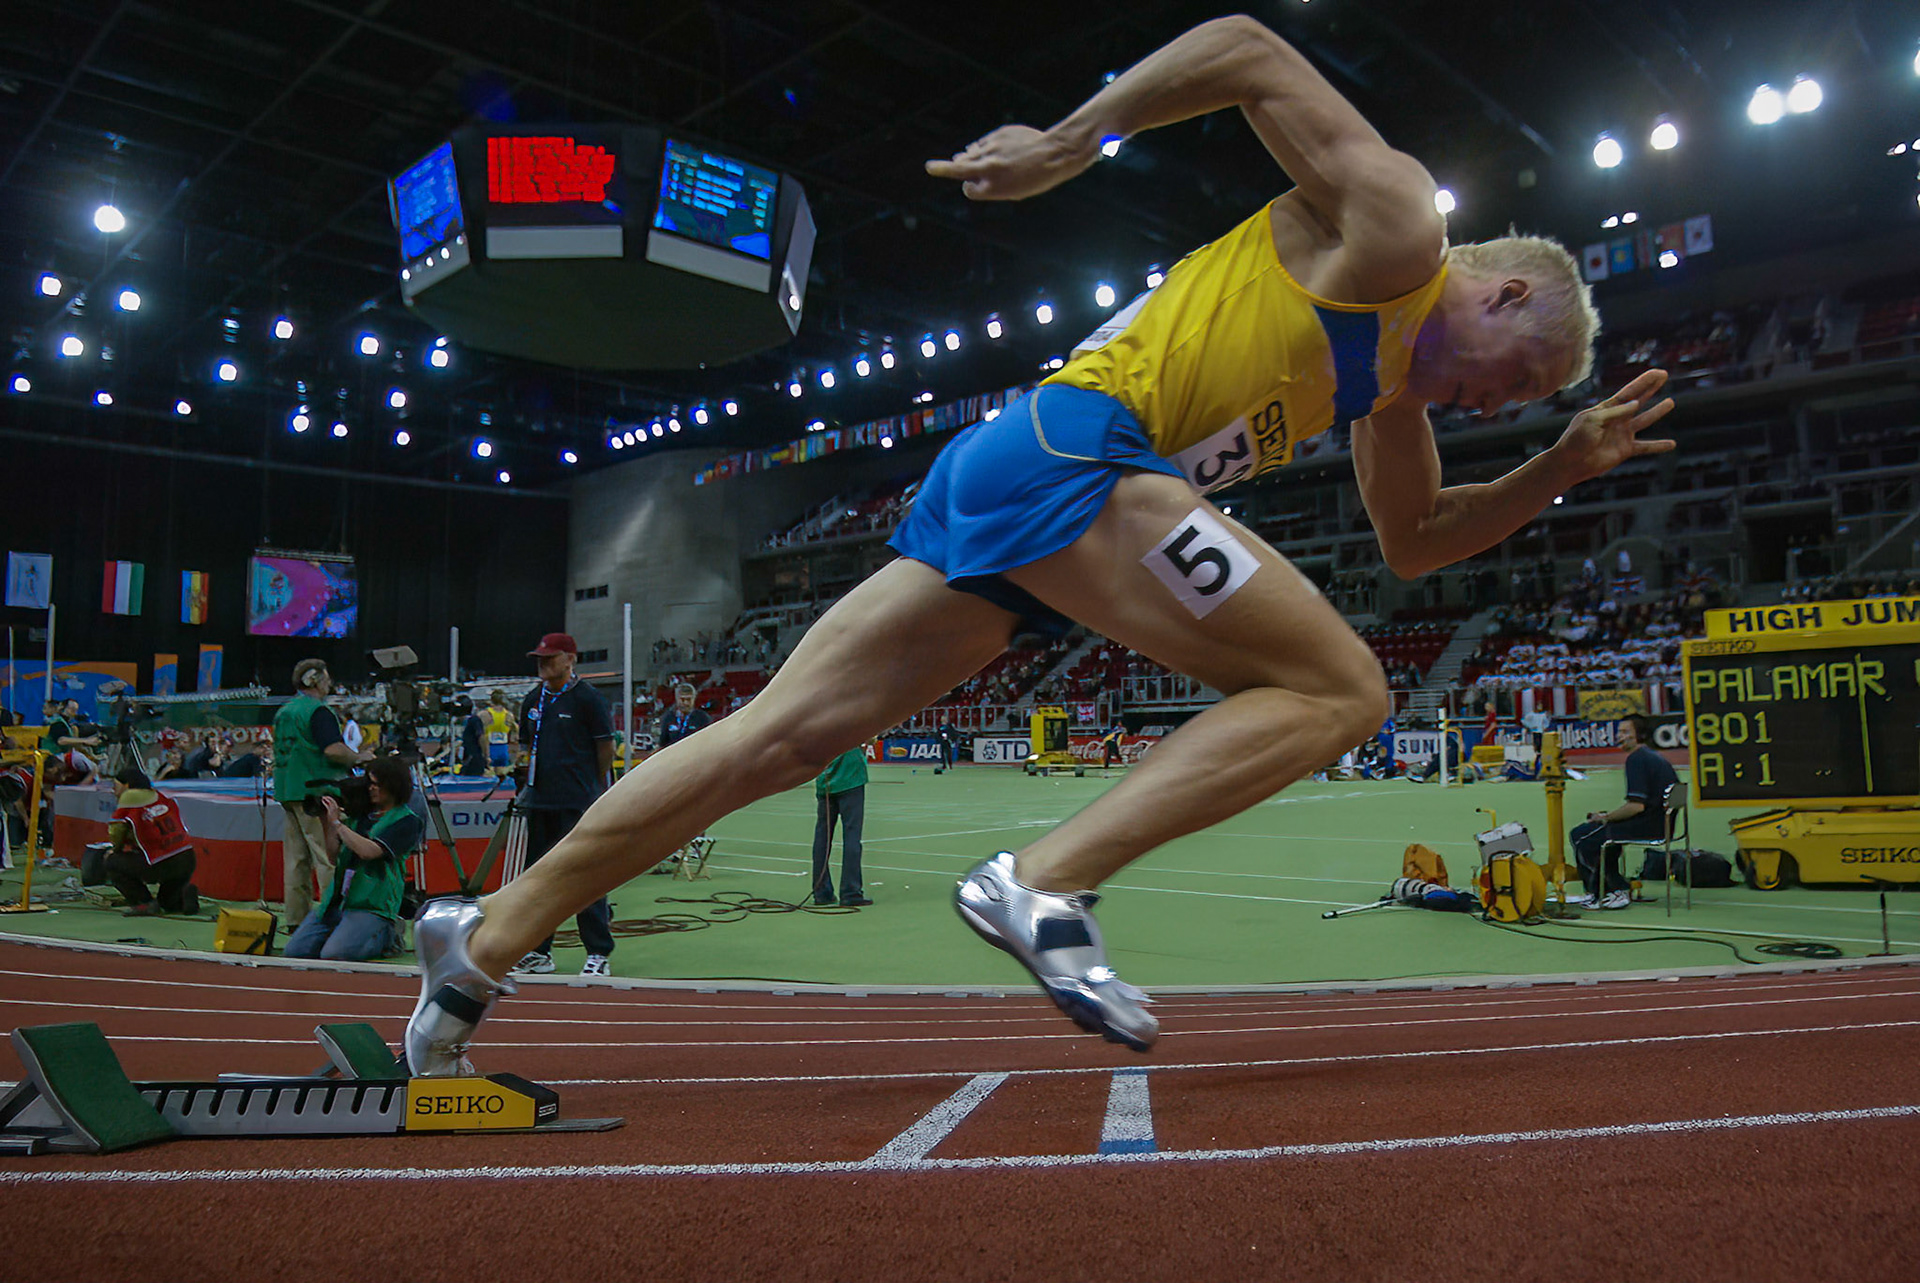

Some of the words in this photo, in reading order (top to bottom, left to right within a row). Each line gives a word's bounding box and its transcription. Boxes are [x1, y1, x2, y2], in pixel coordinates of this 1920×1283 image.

[1162, 525, 1231, 596] 5
[1729, 606, 1822, 633] HIGH
[1691, 639, 1756, 654] SEIKO
[1692, 660, 1887, 704] PALAMAR
[1696, 711, 1772, 745] 801
[415, 1095, 504, 1115] SEIKO
